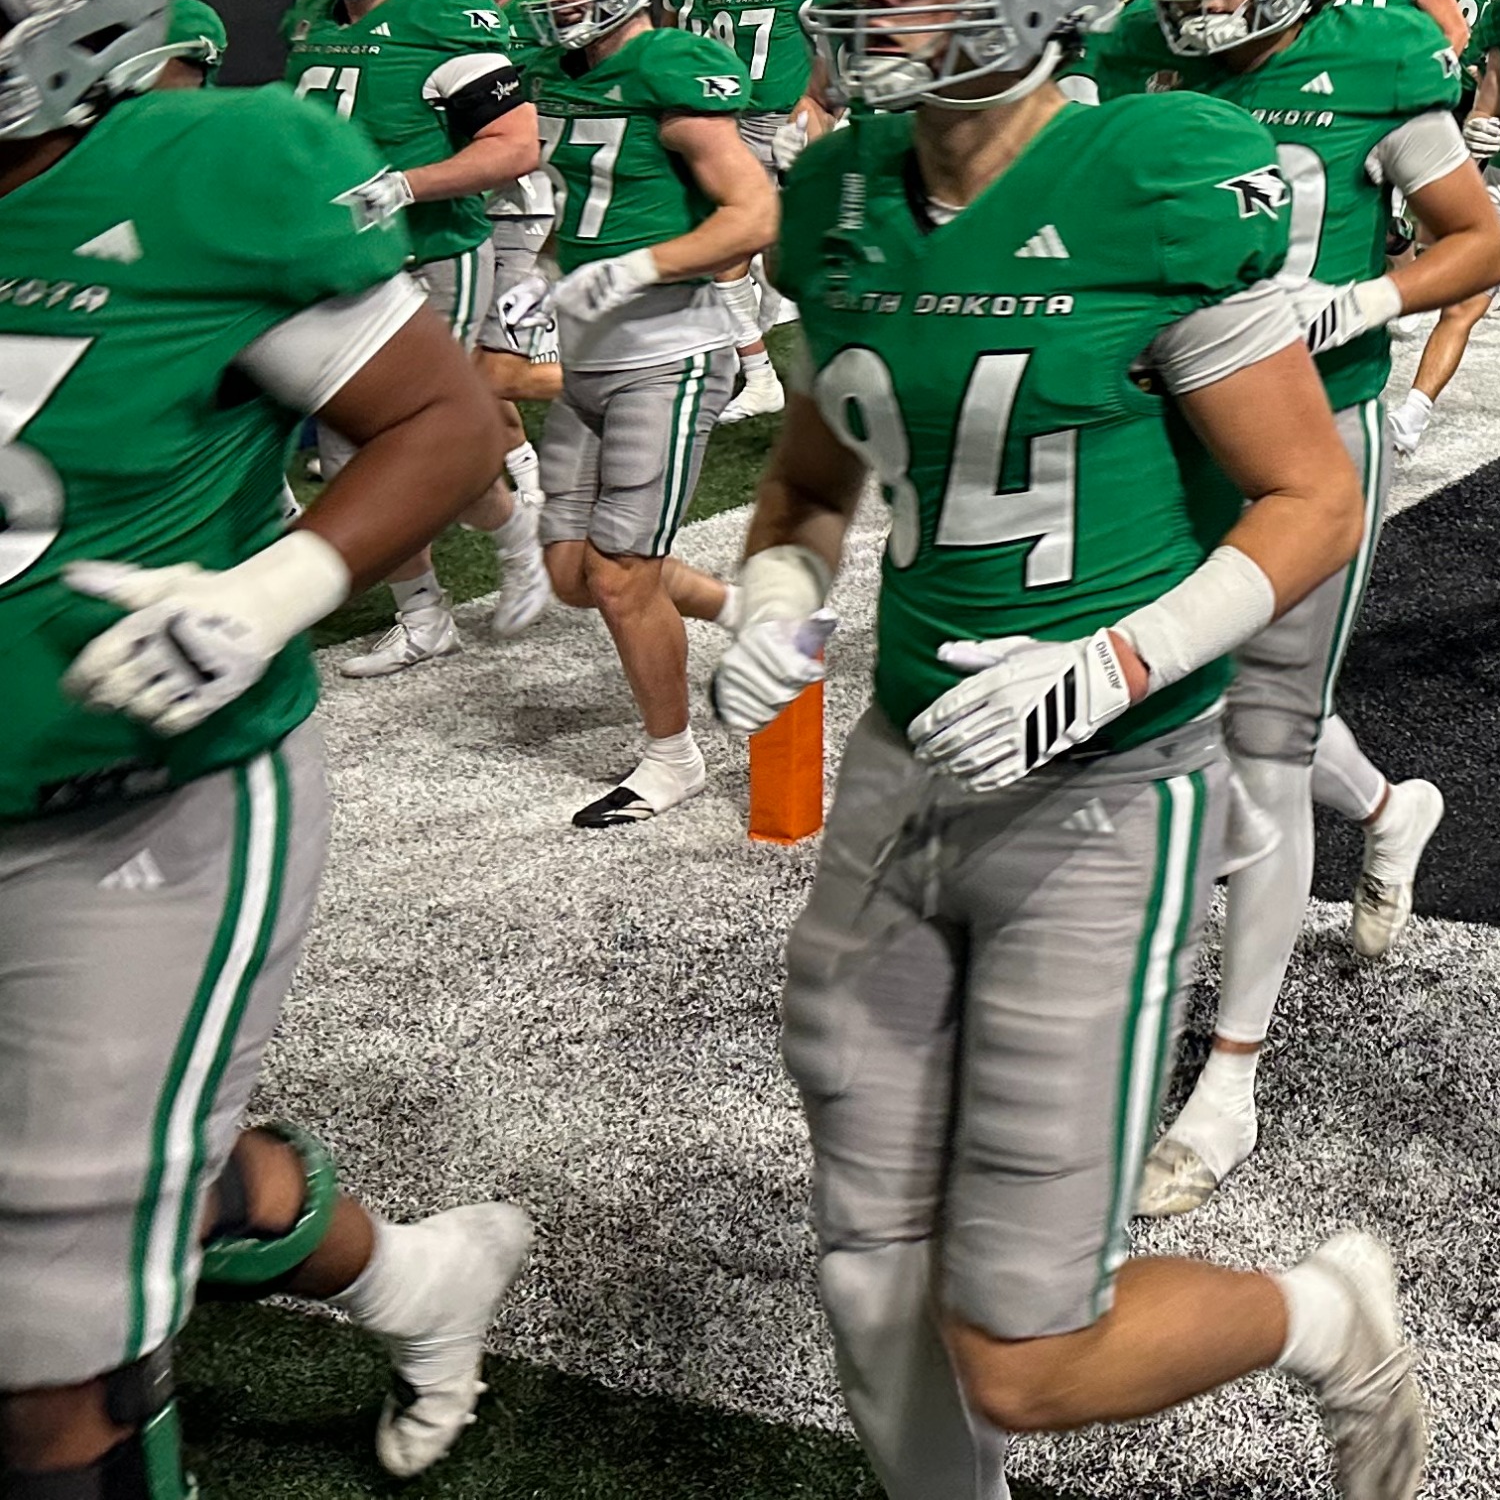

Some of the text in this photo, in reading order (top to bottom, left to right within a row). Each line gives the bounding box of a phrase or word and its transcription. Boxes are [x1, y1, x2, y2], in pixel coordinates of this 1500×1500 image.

[1251, 108, 1334, 128] AKOTA
[911, 292, 1077, 317] DAKOTA
[813, 347, 1078, 589] 84
[1095, 640, 1124, 691] ADIZERO
